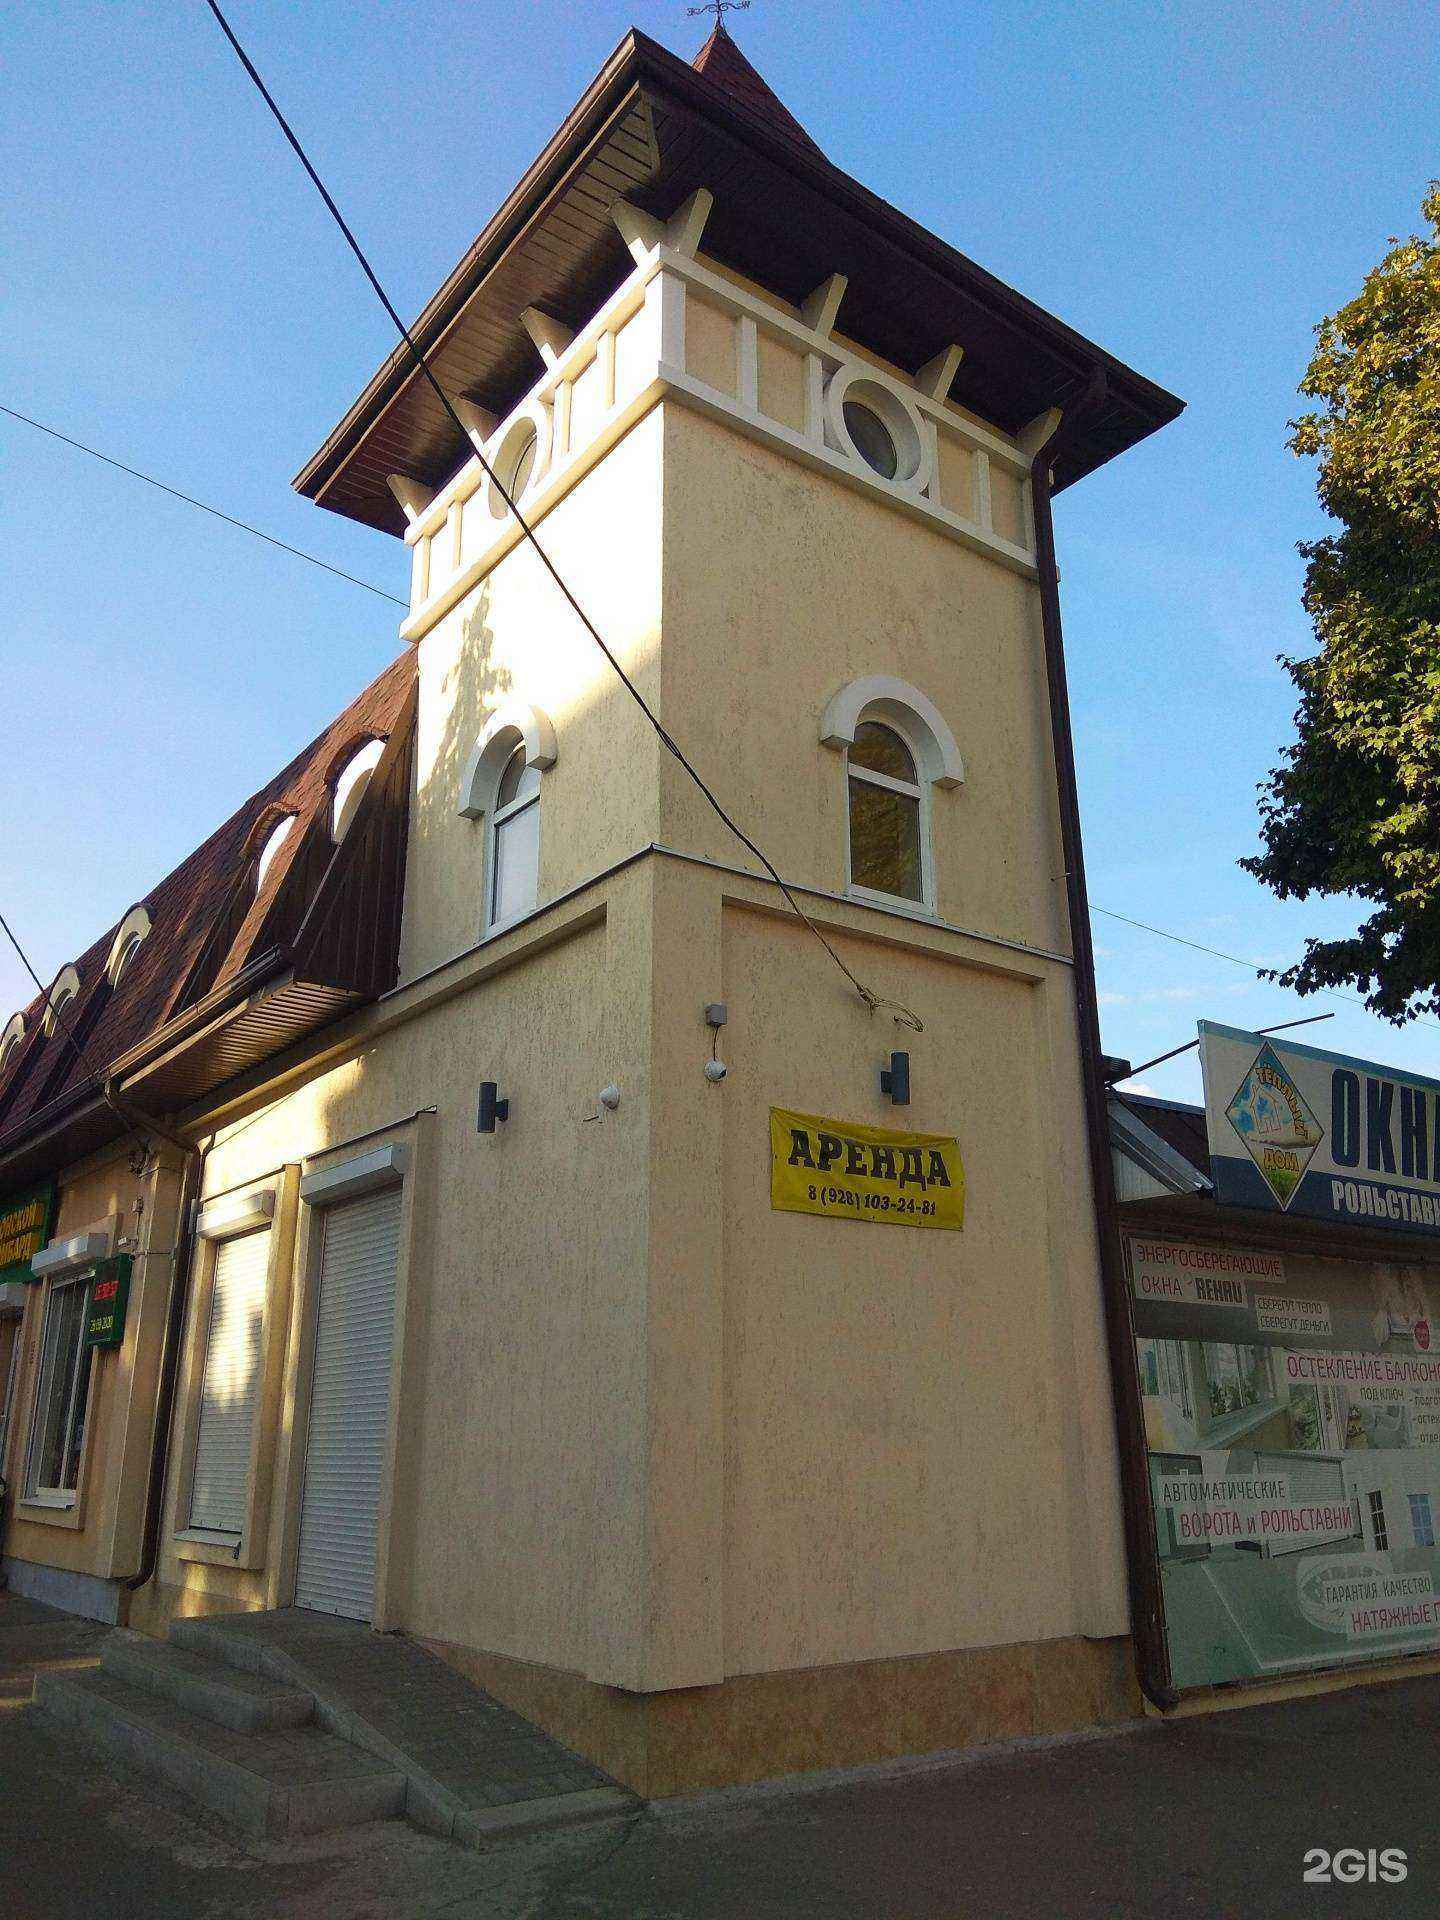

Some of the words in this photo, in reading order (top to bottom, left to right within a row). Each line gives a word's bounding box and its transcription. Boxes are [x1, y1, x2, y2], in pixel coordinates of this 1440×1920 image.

[1331, 1068, 1440, 1182] ОКН
[788, 1129, 951, 1191] АРЕНДА
[1263, 1148, 1300, 1172] ДОМ
[808, 1184, 817, 1200] 8
[864, 1193, 936, 1216] 103-24-81
[1135, 1243, 1281, 1278] ЭНЕРГОСБЕРЕГАЮЩИЕ
[1140, 1275, 1183, 1296] ОКНА
[1287, 1356, 1383, 1381] ОСТЕКЛЕНИЕ
[1163, 1480, 1286, 1502] АВТОМАТИЧЕСКИЕ
[1180, 1512, 1243, 1538] ВОРОТА
[1261, 1506, 1352, 1534] РОЛЬСТАВНИ
[1326, 1582, 1378, 1603] ГАРАНТИЯ
[1383, 1576, 1431, 1598] КАЧЕСТВО
[1351, 1603, 1431, 1633] НАТЯЖНЫЕ
